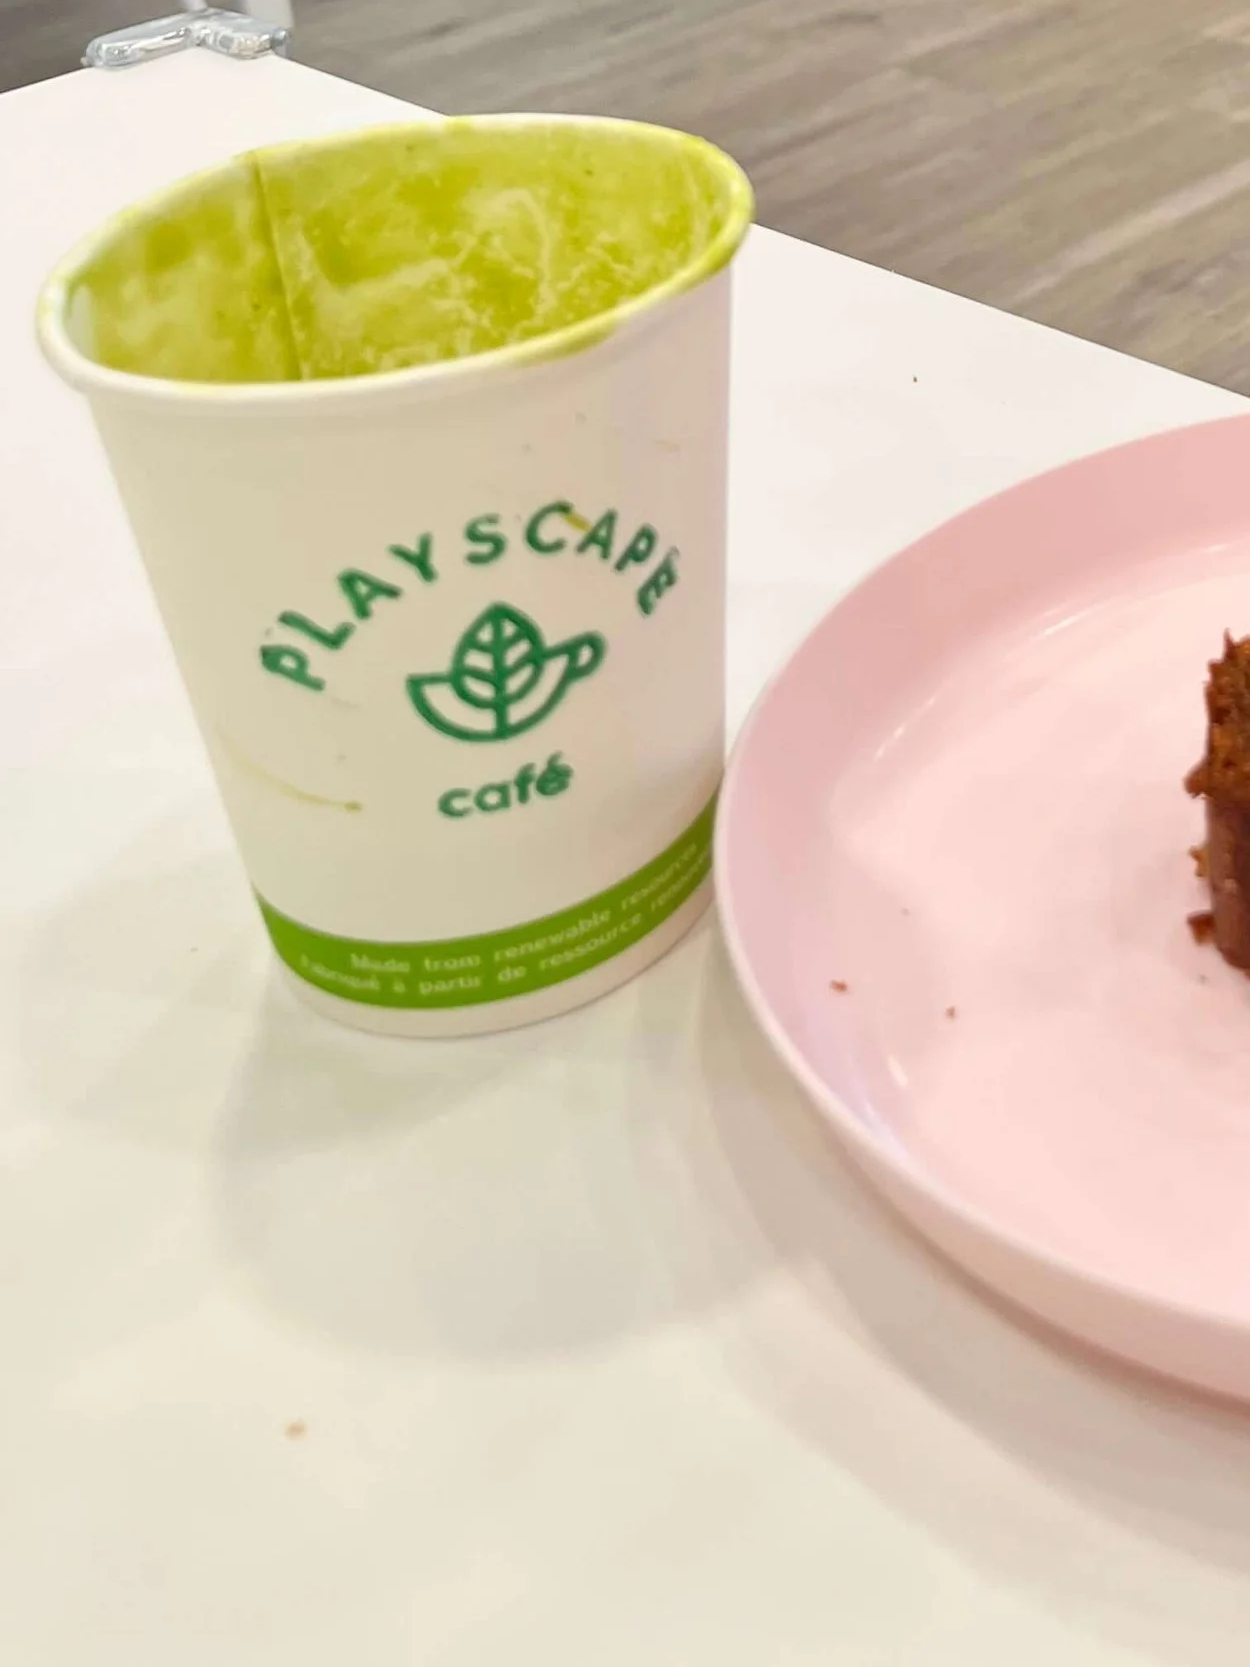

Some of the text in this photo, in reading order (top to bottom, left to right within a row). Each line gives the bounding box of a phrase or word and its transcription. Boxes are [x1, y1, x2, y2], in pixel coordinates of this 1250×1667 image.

[437, 752, 575, 819] café
[350, 953, 411, 973] Made
[423, 954, 481, 972] from
[494, 909, 611, 963] renewable
[418, 975, 482, 996] partir
[497, 964, 527, 984] de
[539, 912, 642, 972] ressource
